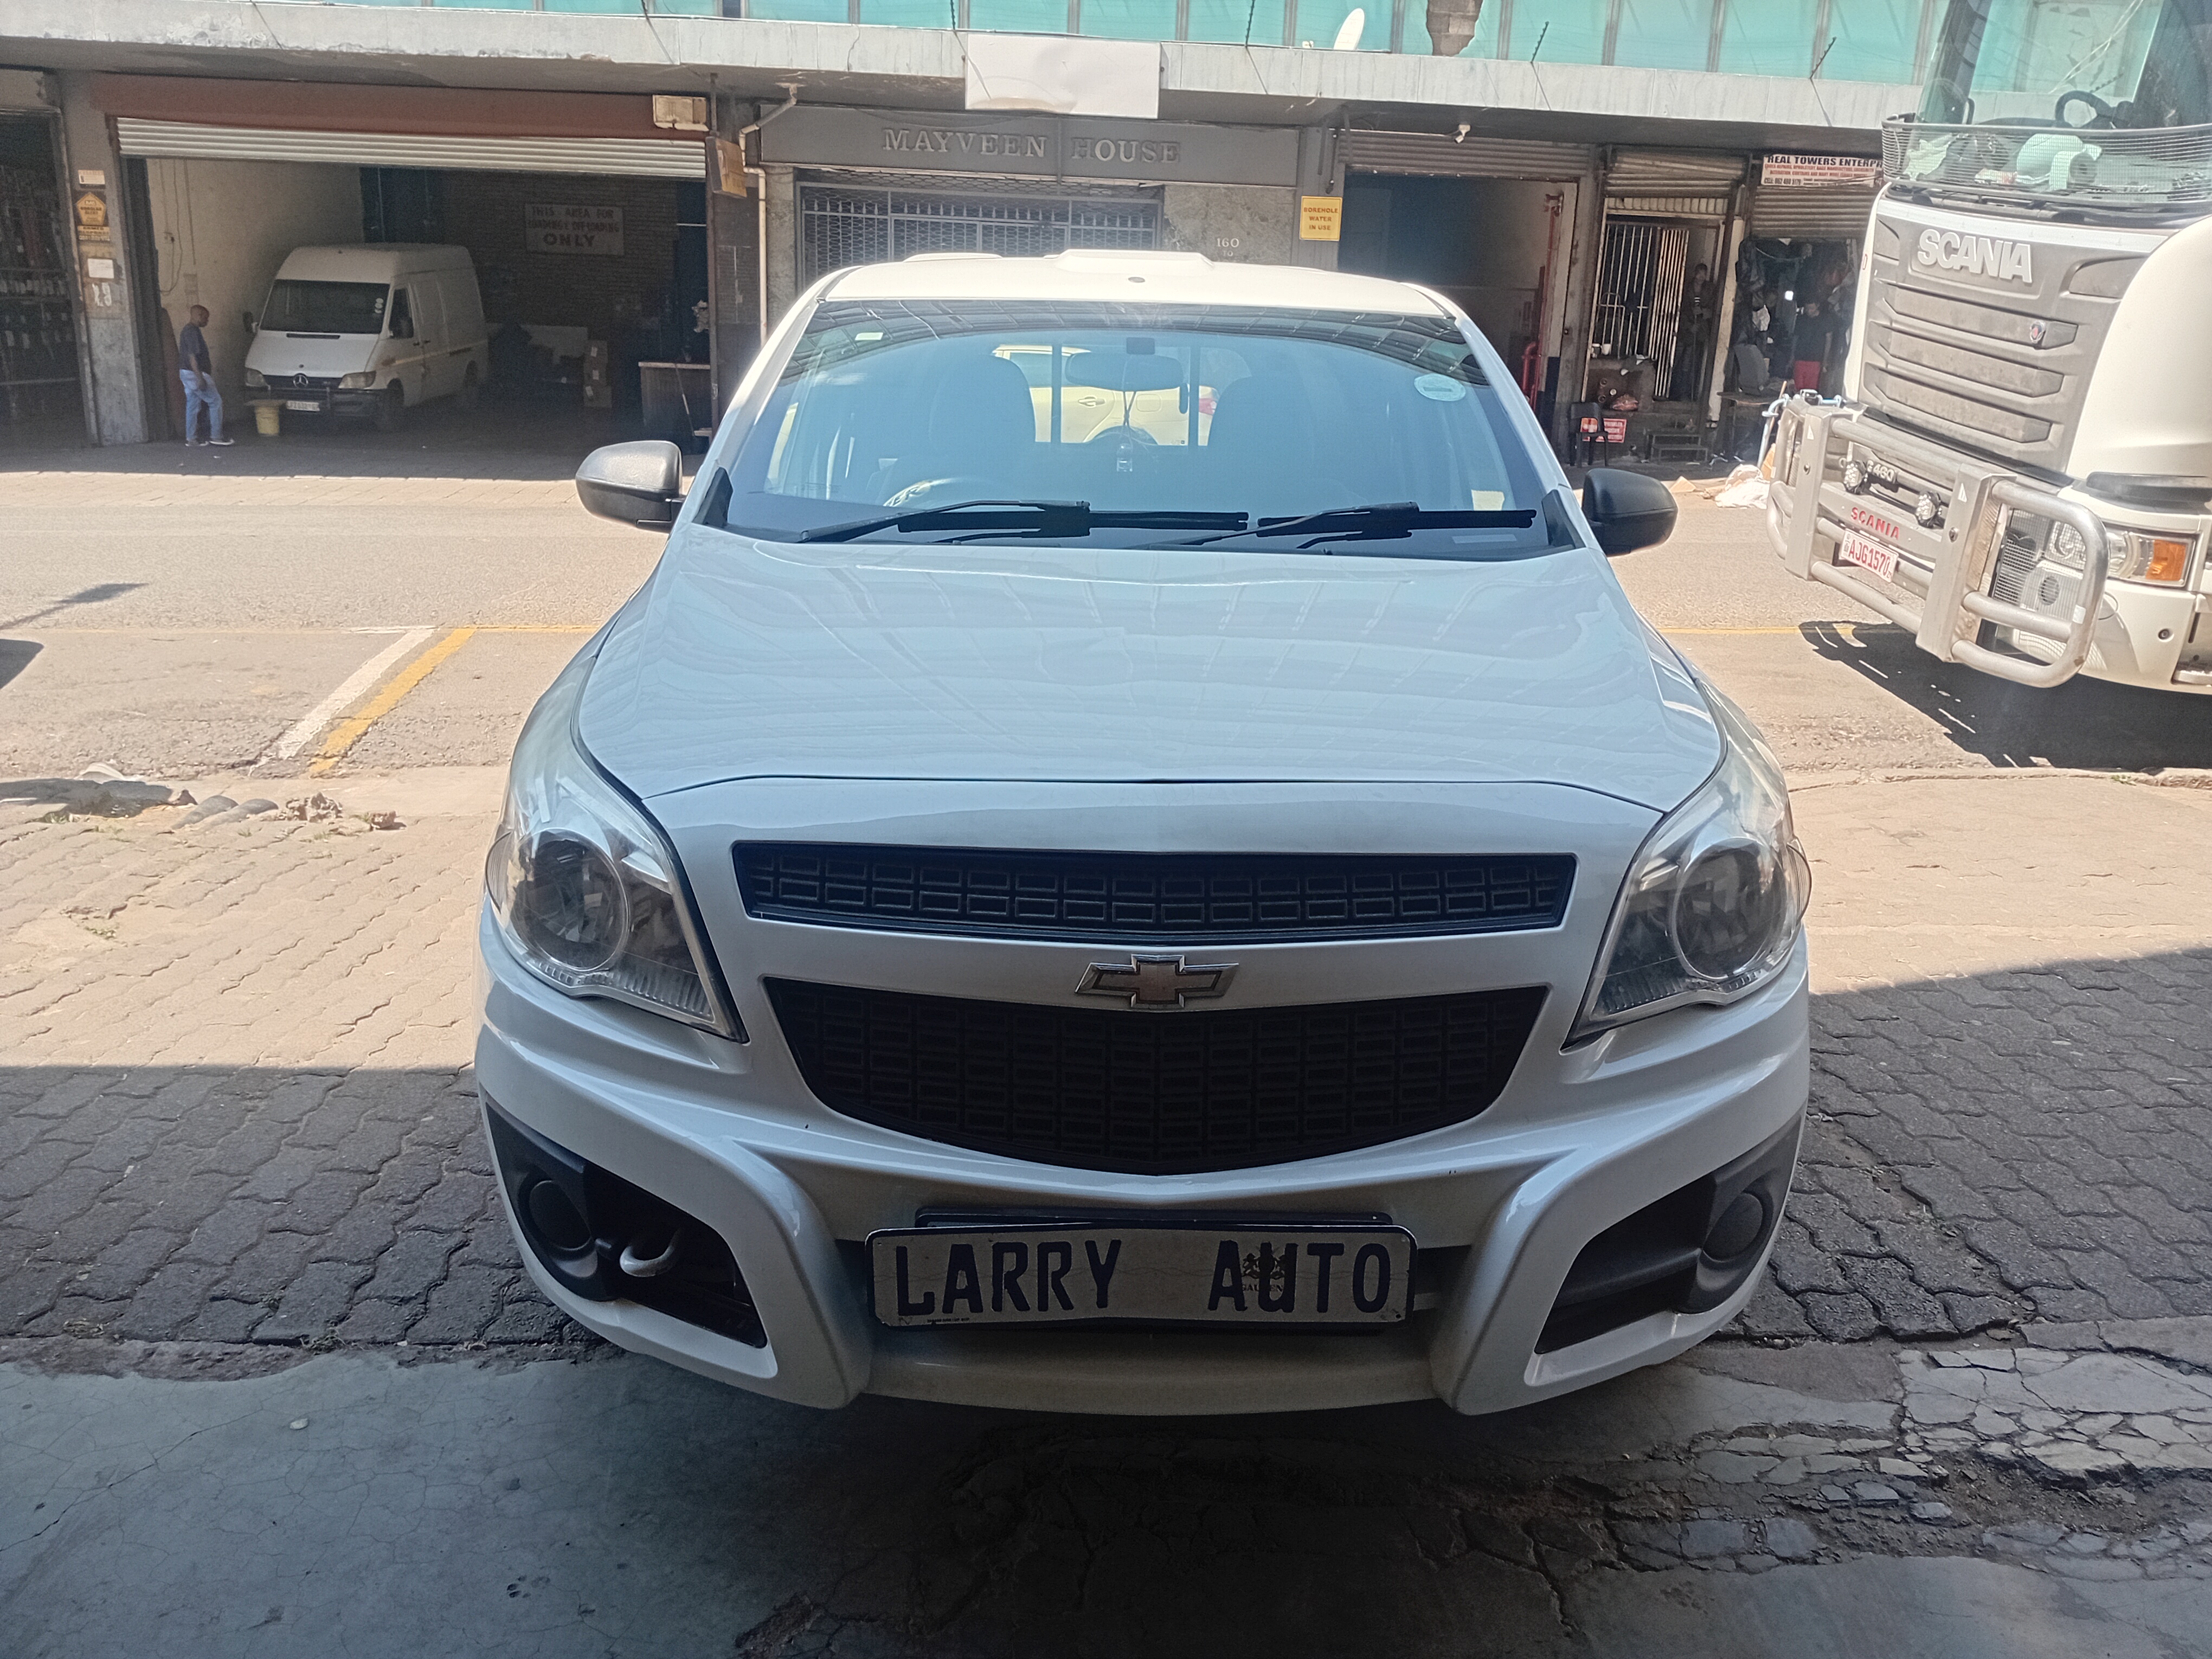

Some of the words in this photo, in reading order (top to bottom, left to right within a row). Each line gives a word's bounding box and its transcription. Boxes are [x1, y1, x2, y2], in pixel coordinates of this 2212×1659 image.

[882, 128, 1047, 157] MAYVEEN
[1071, 138, 1180, 162] HOUSE
[1795, 157, 1836, 166] TOWERS
[543, 233, 595, 247] ONLY
[1217, 237, 1239, 248] 160
[1918, 229, 2032, 283] SCANIA
[1851, 507, 1900, 540] SCANIA
[1848, 539, 1891, 576] AJG1570
[896, 1239, 1122, 1316] LARRY
[1207, 1239, 1391, 1313] AUTO
